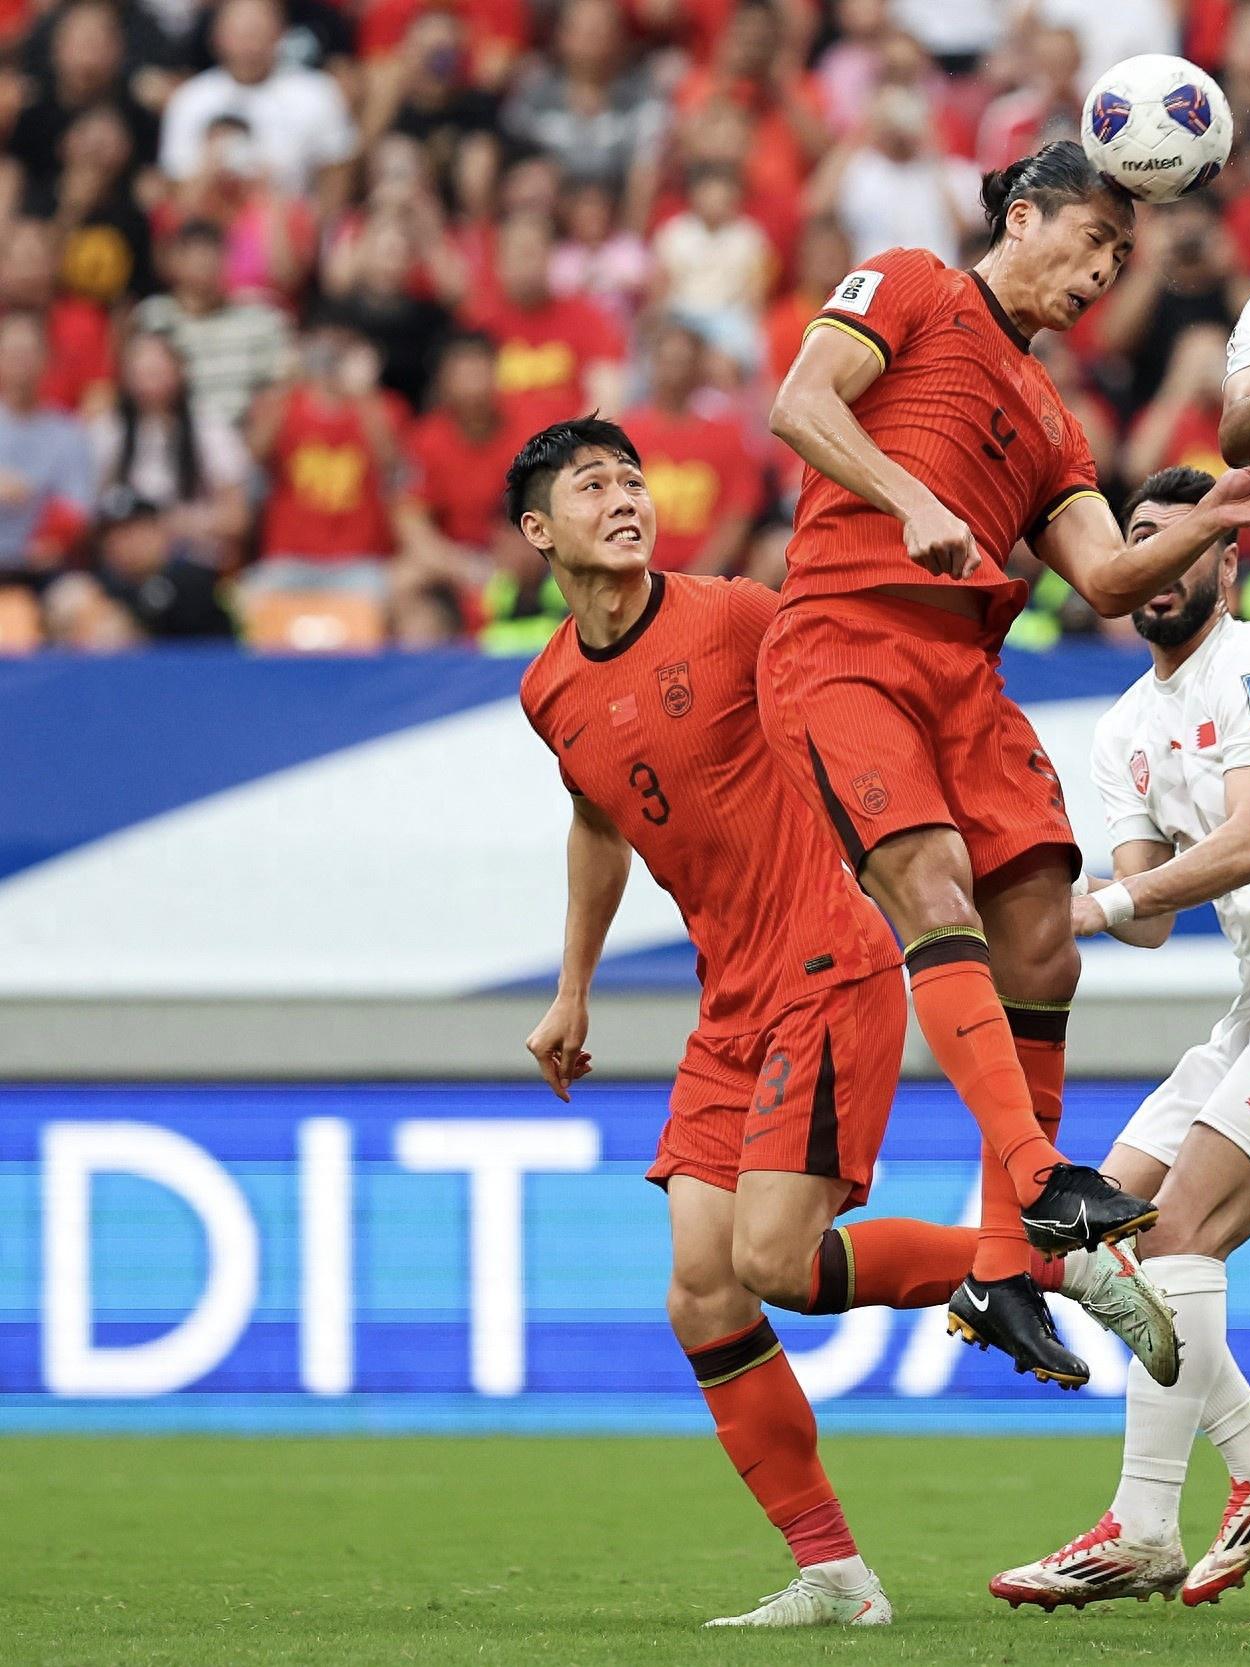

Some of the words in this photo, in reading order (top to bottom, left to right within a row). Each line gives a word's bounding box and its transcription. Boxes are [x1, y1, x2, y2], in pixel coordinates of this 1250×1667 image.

[1122, 155, 1182, 172] molten
[660, 664, 686, 682] CFA
[628, 761, 671, 827] 3
[755, 1052, 791, 1114] 3
[40, 1116, 602, 1399] DIT
